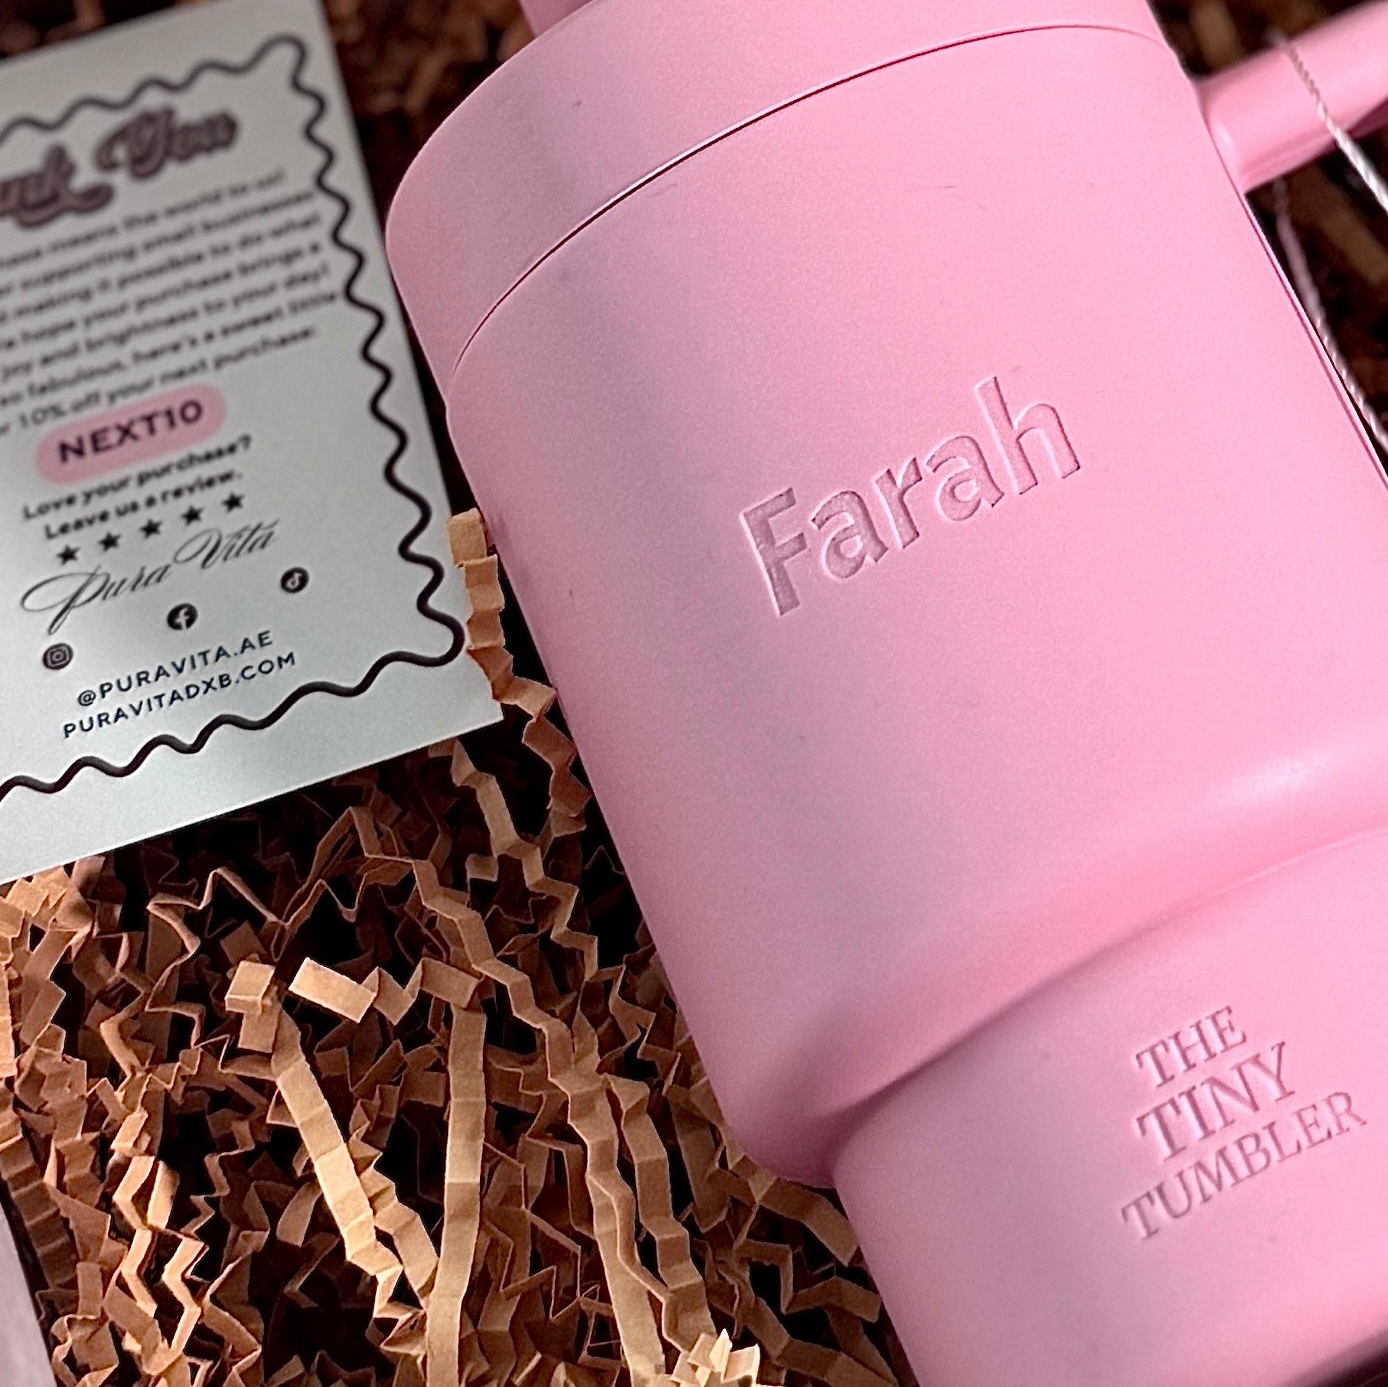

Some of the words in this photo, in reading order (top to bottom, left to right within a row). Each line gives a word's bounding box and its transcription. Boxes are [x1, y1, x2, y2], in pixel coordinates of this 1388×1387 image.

[95, 103, 238, 182] You
[13, 287, 94, 319] making
[117, 252, 206, 291] possible
[20, 245, 137, 291] supporting
[20, 319, 78, 344] hope
[134, 270, 234, 313] purchase
[39, 342, 81, 368] and
[84, 308, 199, 353] brightness
[231, 282, 278, 309] your
[19, 403, 68, 428] 10%
[106, 376, 155, 405] your
[159, 359, 208, 384] next
[58, 400, 203, 463] NEXT10
[23, 494, 77, 520] Love
[82, 476, 131, 506] your
[136, 434, 251, 487] purchase?
[45, 510, 109, 540] Leave
[115, 501, 140, 517] us
[145, 496, 156, 508] a
[161, 471, 243, 502] review.
[738, 376, 1082, 616] Farah
[20, 564, 173, 636] Pura
[62, 652, 296, 739] PURAVITADXB.COM
[77, 631, 273, 707] @PURAVITA.AE
[1135, 1005, 1247, 1089] THE
[1135, 1041, 1295, 1162] TINY
[1120, 1091, 1367, 1241] TUMBLER
